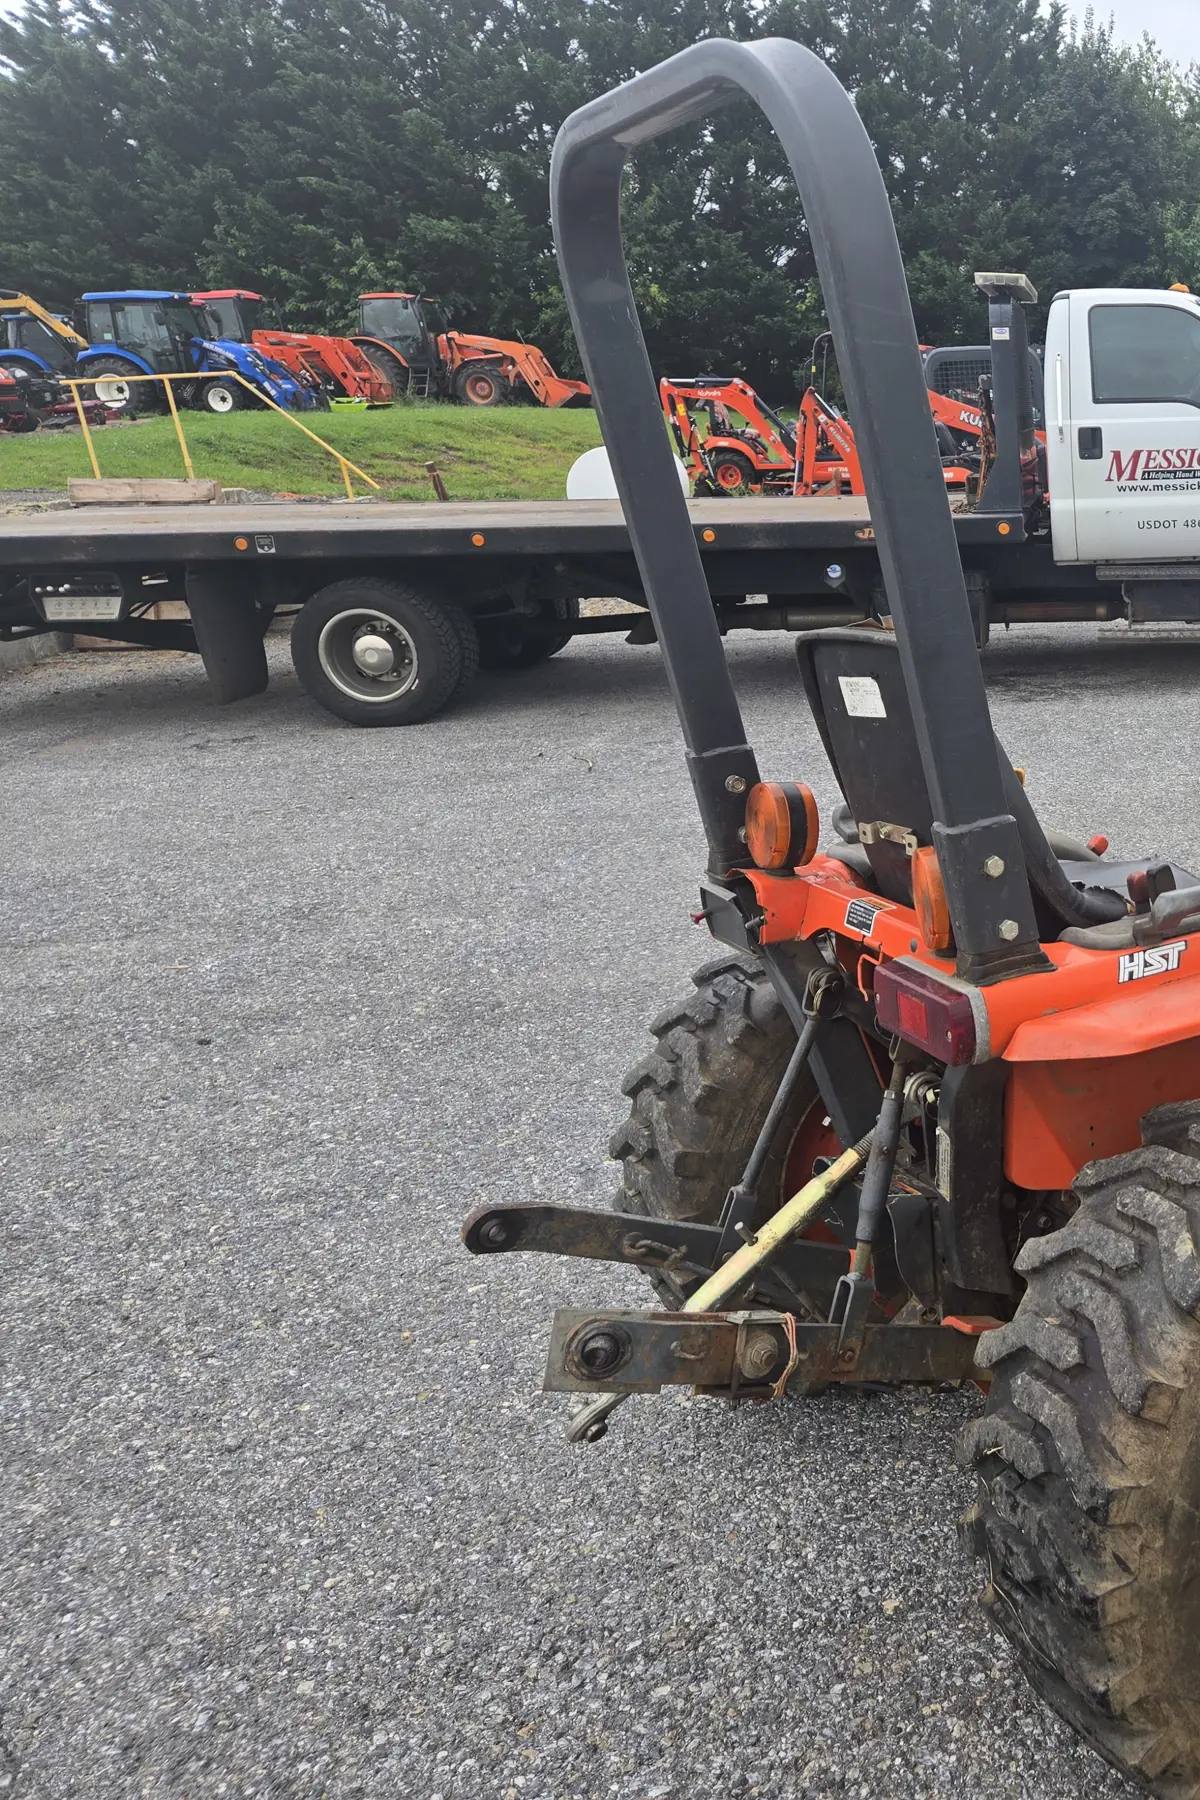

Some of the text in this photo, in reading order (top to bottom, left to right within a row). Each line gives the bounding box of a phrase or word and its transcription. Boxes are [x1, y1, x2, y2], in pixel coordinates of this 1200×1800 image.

[1149, 471, 1174, 480] Helping
[1175, 470, 1194, 478] Hand
[1137, 520, 1178, 530] USDOT
[1118, 940, 1187, 984] HST
